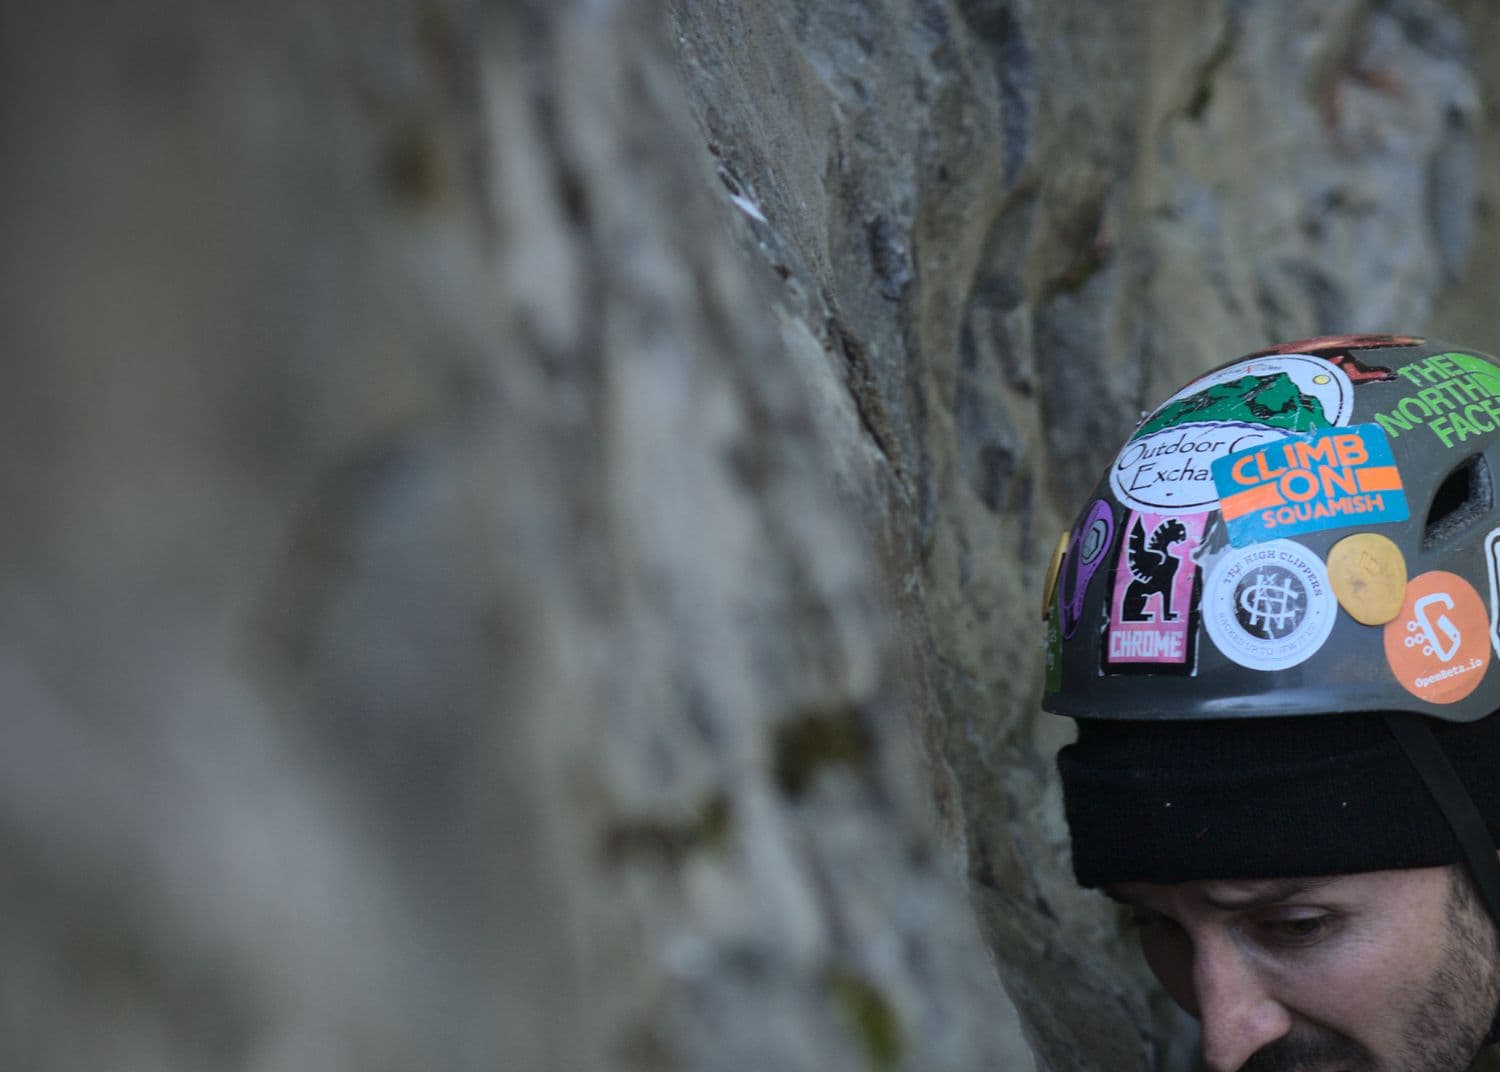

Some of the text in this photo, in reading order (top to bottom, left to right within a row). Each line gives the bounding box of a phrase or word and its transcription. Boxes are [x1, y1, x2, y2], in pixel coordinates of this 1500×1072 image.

[1397, 355, 1465, 387] THE
[1374, 374, 1491, 438] NORTH
[1118, 433, 1227, 471] Outdoor
[1231, 434, 1369, 485] CLIMB
[1129, 458, 1213, 492] Excha
[1280, 465, 1358, 502] ON
[1262, 494, 1385, 528] SQUAMISH
[1243, 550, 1276, 564] HIGH
[1279, 551, 1323, 597] CLIPPERS
[1110, 630, 1184, 657] CHROME
[1414, 658, 1483, 688] OpenBeta.io
